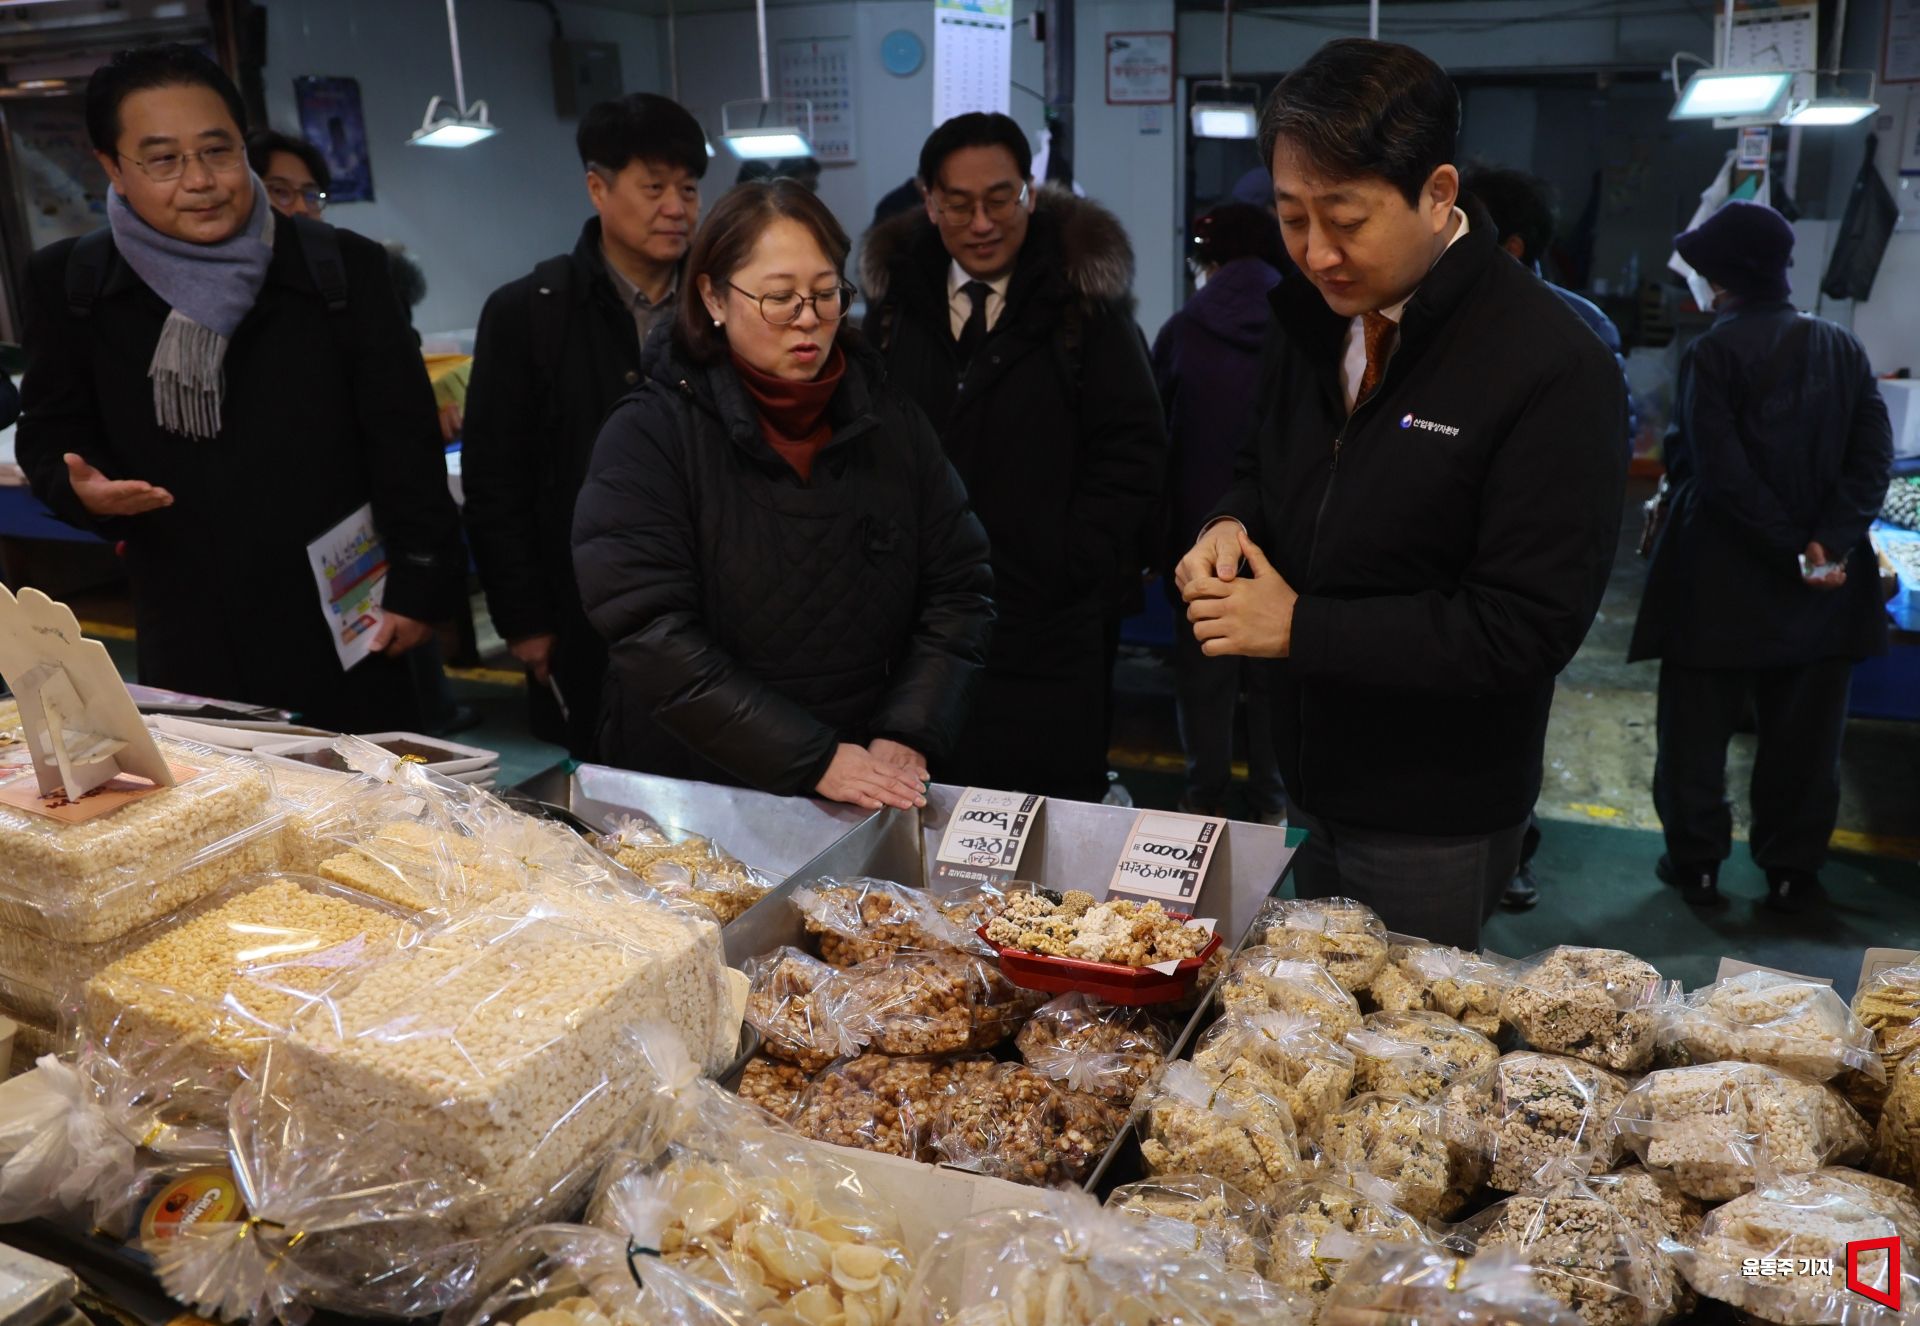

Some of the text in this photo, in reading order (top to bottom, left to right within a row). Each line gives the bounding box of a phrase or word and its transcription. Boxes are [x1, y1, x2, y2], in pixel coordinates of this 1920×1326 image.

[1413, 418, 1460, 437] 산업통상자원부
[963, 810, 1008, 831] 5000
[959, 837, 1003, 853] 오란다
